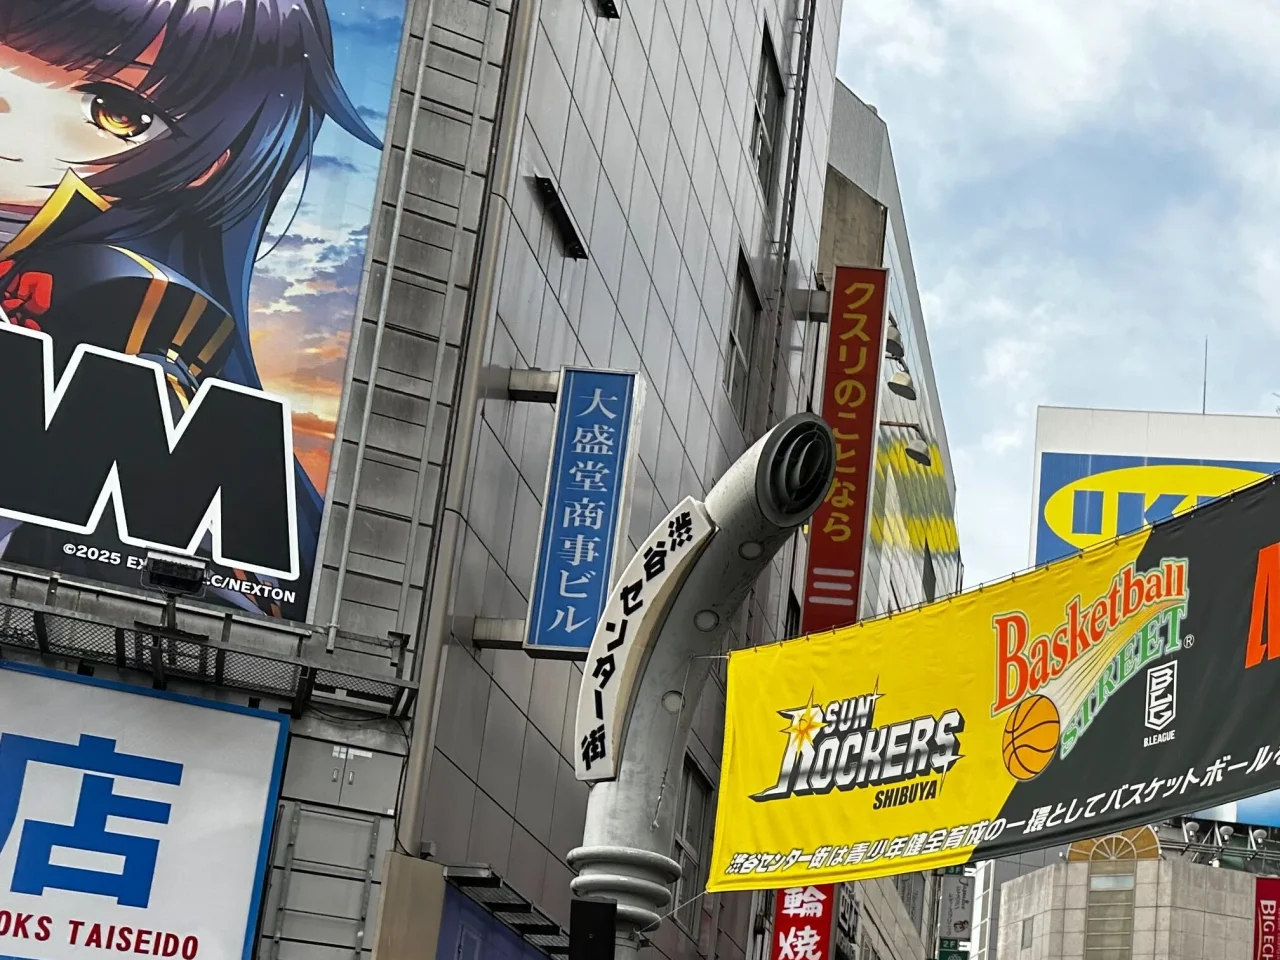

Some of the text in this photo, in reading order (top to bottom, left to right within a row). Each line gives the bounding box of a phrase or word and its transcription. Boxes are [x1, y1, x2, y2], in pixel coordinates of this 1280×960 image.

[821, 282, 876, 543] クスリのことなら
[545, 386, 617, 636] 大盛堂商事ビル
[581, 511, 693, 771] 渋谷センター街
[992, 559, 1187, 716] Basketball
[1060, 604, 1187, 760] STREET
[748, 705, 965, 802] ROCKERS
[823, 694, 872, 734] SUN
[1143, 730, 1175, 747] B.LEAGUE
[0, 732, 184, 909] 店
[873, 780, 938, 809] SHIBUYA
[68, 919, 199, 960] TAISEIDO
[942, 940, 956, 949] 2F
[1260, 900, 1277, 937] BIG
